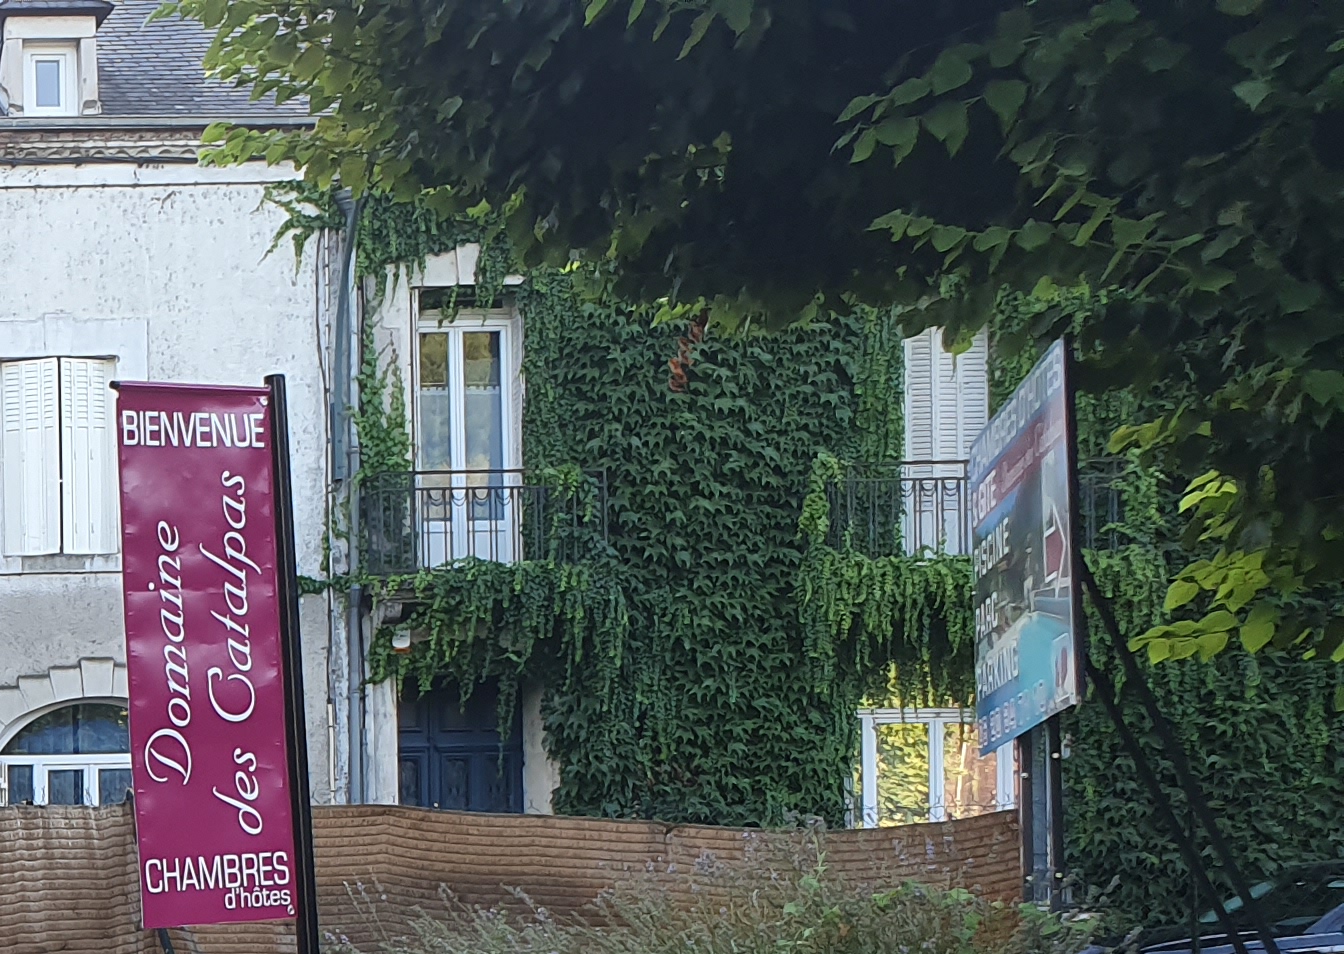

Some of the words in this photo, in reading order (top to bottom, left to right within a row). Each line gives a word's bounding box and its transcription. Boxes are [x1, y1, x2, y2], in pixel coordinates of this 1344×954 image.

[121, 410, 265, 448] BIENVENUE
[973, 517, 1009, 585] PISCINE
[199, 470, 261, 722] Catalpas
[975, 591, 998, 644] PARC
[144, 520, 192, 785] Domaine
[977, 640, 1019, 702] PARKING
[212, 747, 263, 835] des
[145, 851, 290, 893] CHAMBRES
[224, 886, 291, 909] d'hôtes
